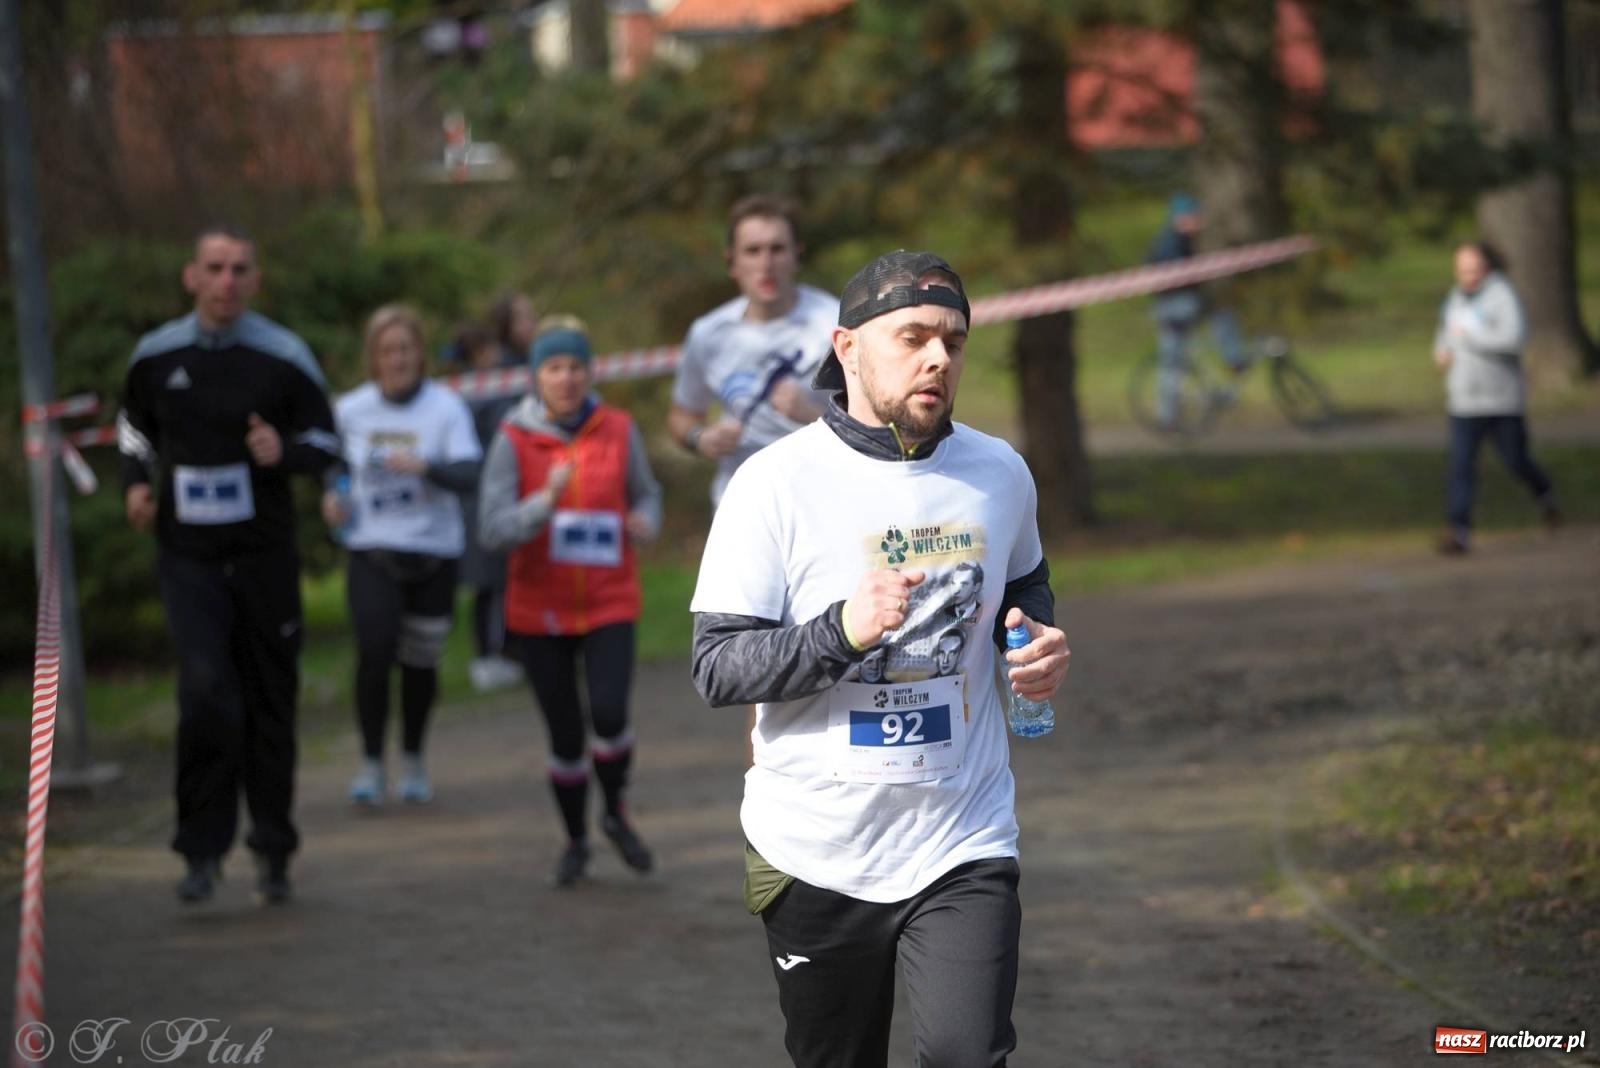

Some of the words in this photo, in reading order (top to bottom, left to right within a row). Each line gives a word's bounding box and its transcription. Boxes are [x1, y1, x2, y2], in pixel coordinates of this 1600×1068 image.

[911, 526, 941, 538] TROPEM
[912, 533, 972, 554] WILCZYM
[893, 692, 929, 705] WILCZYM
[881, 711, 925, 745] 92
